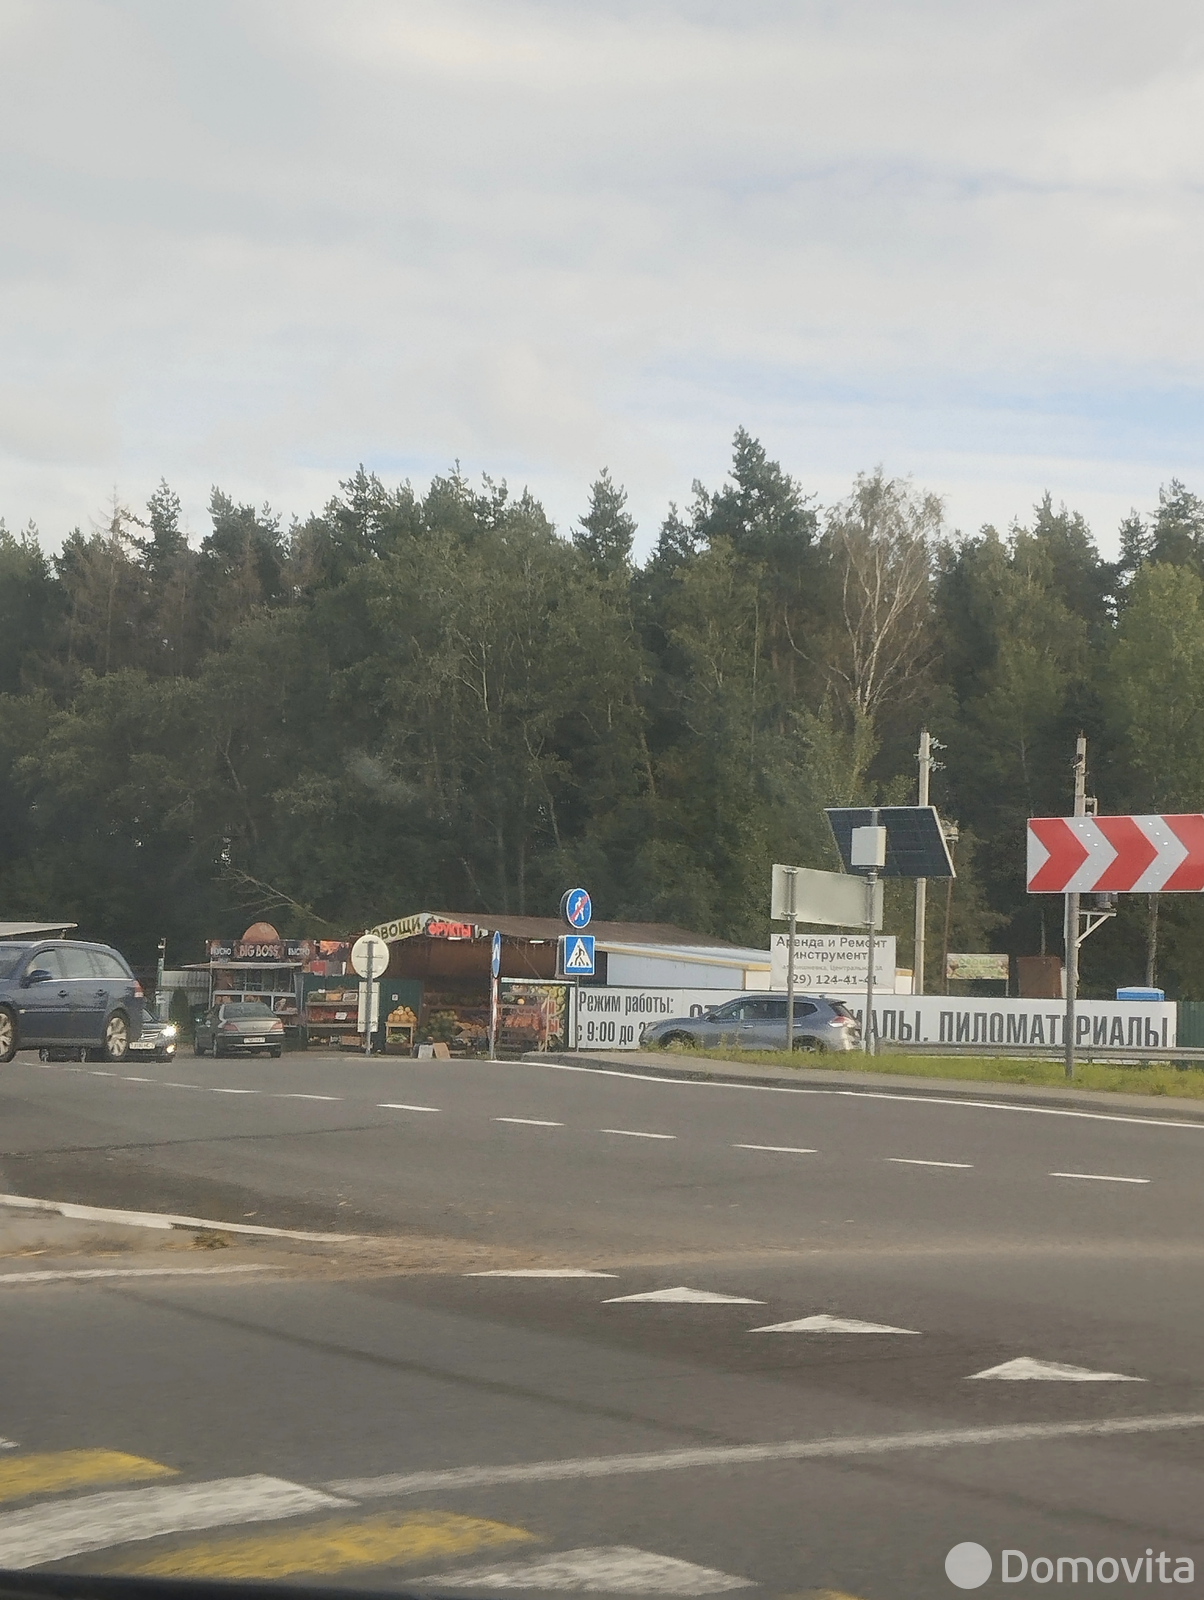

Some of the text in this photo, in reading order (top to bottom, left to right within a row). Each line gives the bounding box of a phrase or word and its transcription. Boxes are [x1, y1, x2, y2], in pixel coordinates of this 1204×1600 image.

[239, 944, 279, 957] BIG BOSS
[828, 939, 836, 948] и
[840, 937, 887, 948] Ремонт
[579, 991, 621, 1012] Режим
[625, 993, 674, 1016] работы:
[587, 1021, 616, 1042] 9:00
[619, 1025, 634, 1045] до
